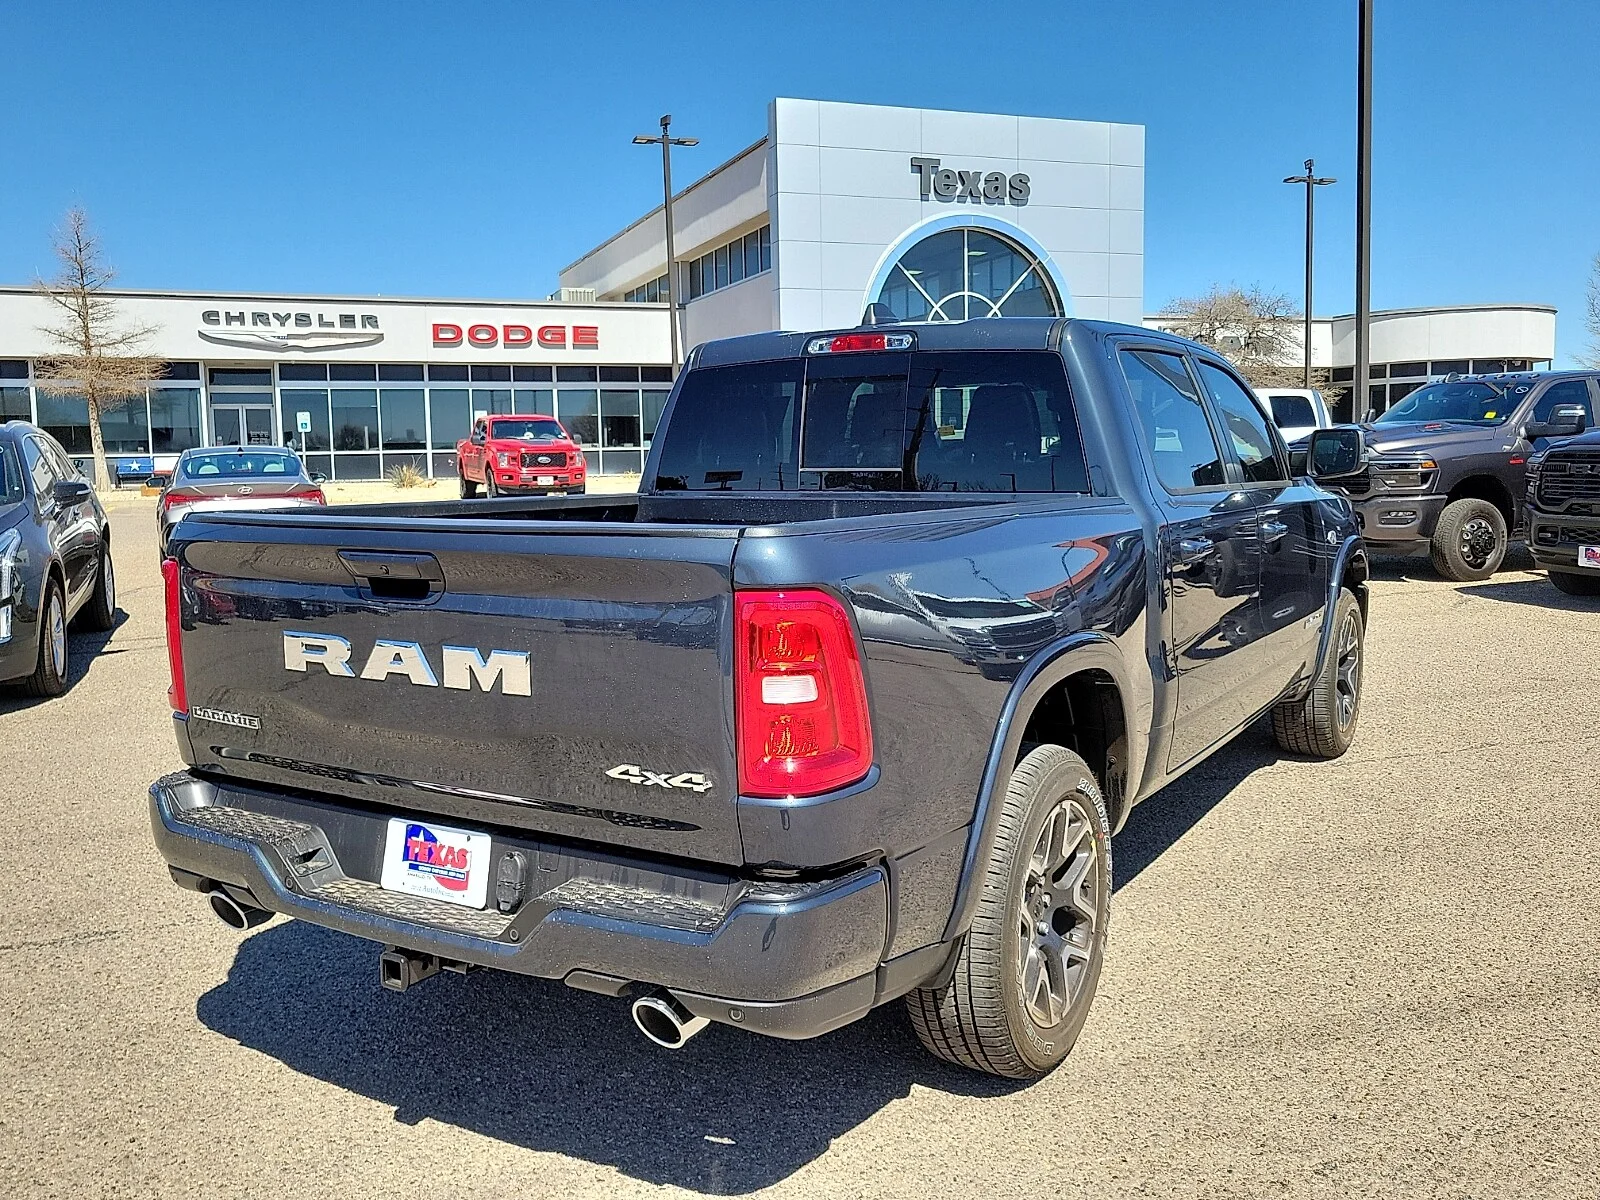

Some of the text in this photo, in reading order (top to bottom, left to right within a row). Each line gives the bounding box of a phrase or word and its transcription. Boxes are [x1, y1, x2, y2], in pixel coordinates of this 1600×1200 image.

[910, 157, 1031, 204] Texas
[202, 311, 380, 329] CHRYSLER
[432, 324, 599, 346] DODGE
[283, 630, 532, 696] RAM
[604, 764, 713, 793] 4x4
[407, 838, 468, 869] TEXAS
